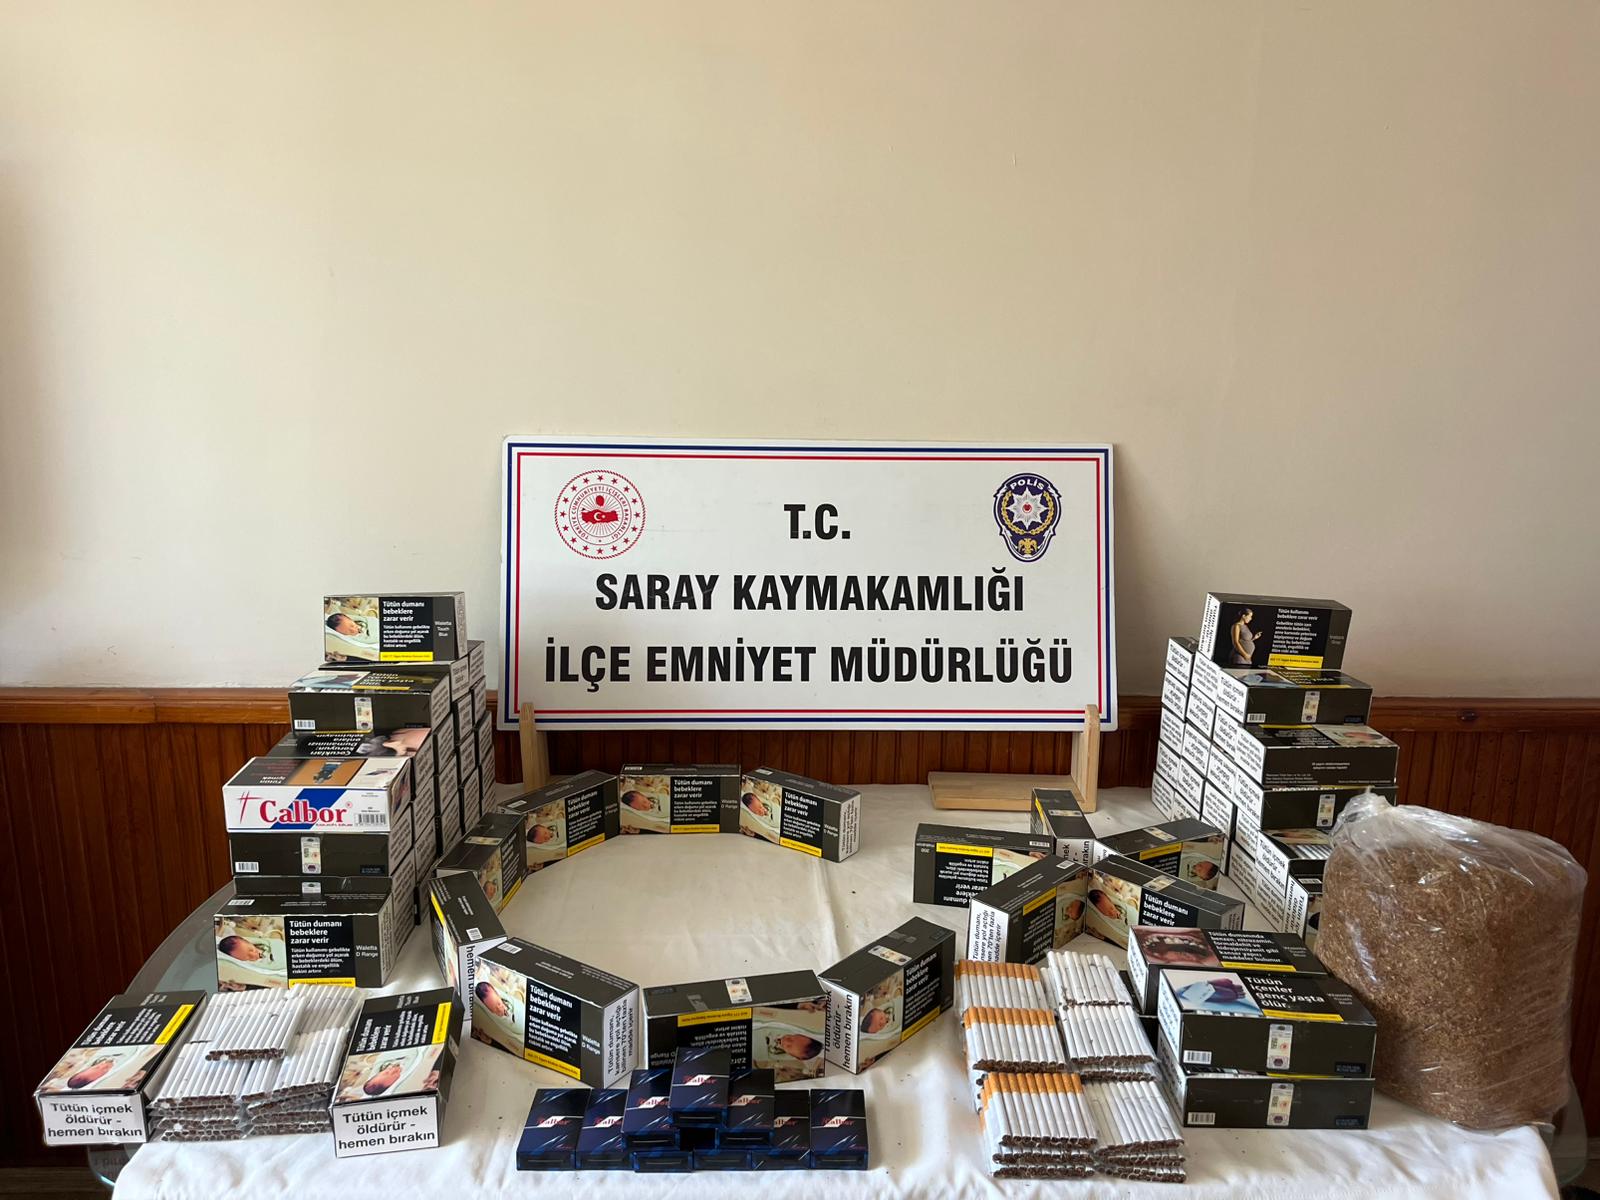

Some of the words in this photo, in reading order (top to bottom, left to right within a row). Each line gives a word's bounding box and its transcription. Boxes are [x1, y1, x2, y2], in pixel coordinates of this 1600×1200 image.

[1010, 479, 1044, 490] POLİS
[784, 504, 850, 540] T.C.
[596, 573, 719, 611] SARAY
[734, 566, 1024, 612] KAYMAKAMLIĞI
[545, 636, 630, 692] İLÇE
[648, 638, 816, 683] EMNİYET
[831, 638, 1072, 684] MÜDÜRLÜĞÜ
[260, 799, 347, 824] Calbor
[1145, 894, 1162, 905] Tütün
[1164, 901, 1188, 915] dumanı
[1244, 976, 1283, 986] Tütün
[1251, 984, 1292, 994] içenler
[530, 984, 548, 998] Tütün
[549, 993, 572, 1008] dumanı
[530, 994, 560, 1012] bebeklere
[1256, 992, 1288, 1002] genç
[1289, 995, 1325, 1003] yaşta
[529, 1004, 546, 1015] zarar
[546, 1011, 561, 1021] verir
[844, 994, 853, 1031] bırakın
[833, 1010, 842, 1049] öldürür
[842, 1034, 851, 1068] hemen
[50, 1103, 88, 1113] Tütün
[92, 1104, 132, 1115] içmek
[342, 1111, 382, 1123] Tütün
[386, 1106, 428, 1120] içmek
[65, 1114, 112, 1125] öldürür
[357, 1121, 406, 1135] öldürür
[48, 1128, 94, 1137] hemen
[98, 1127, 142, 1136] bırakın
[338, 1138, 385, 1149] hemen
[389, 1132, 435, 1144] bırakın
